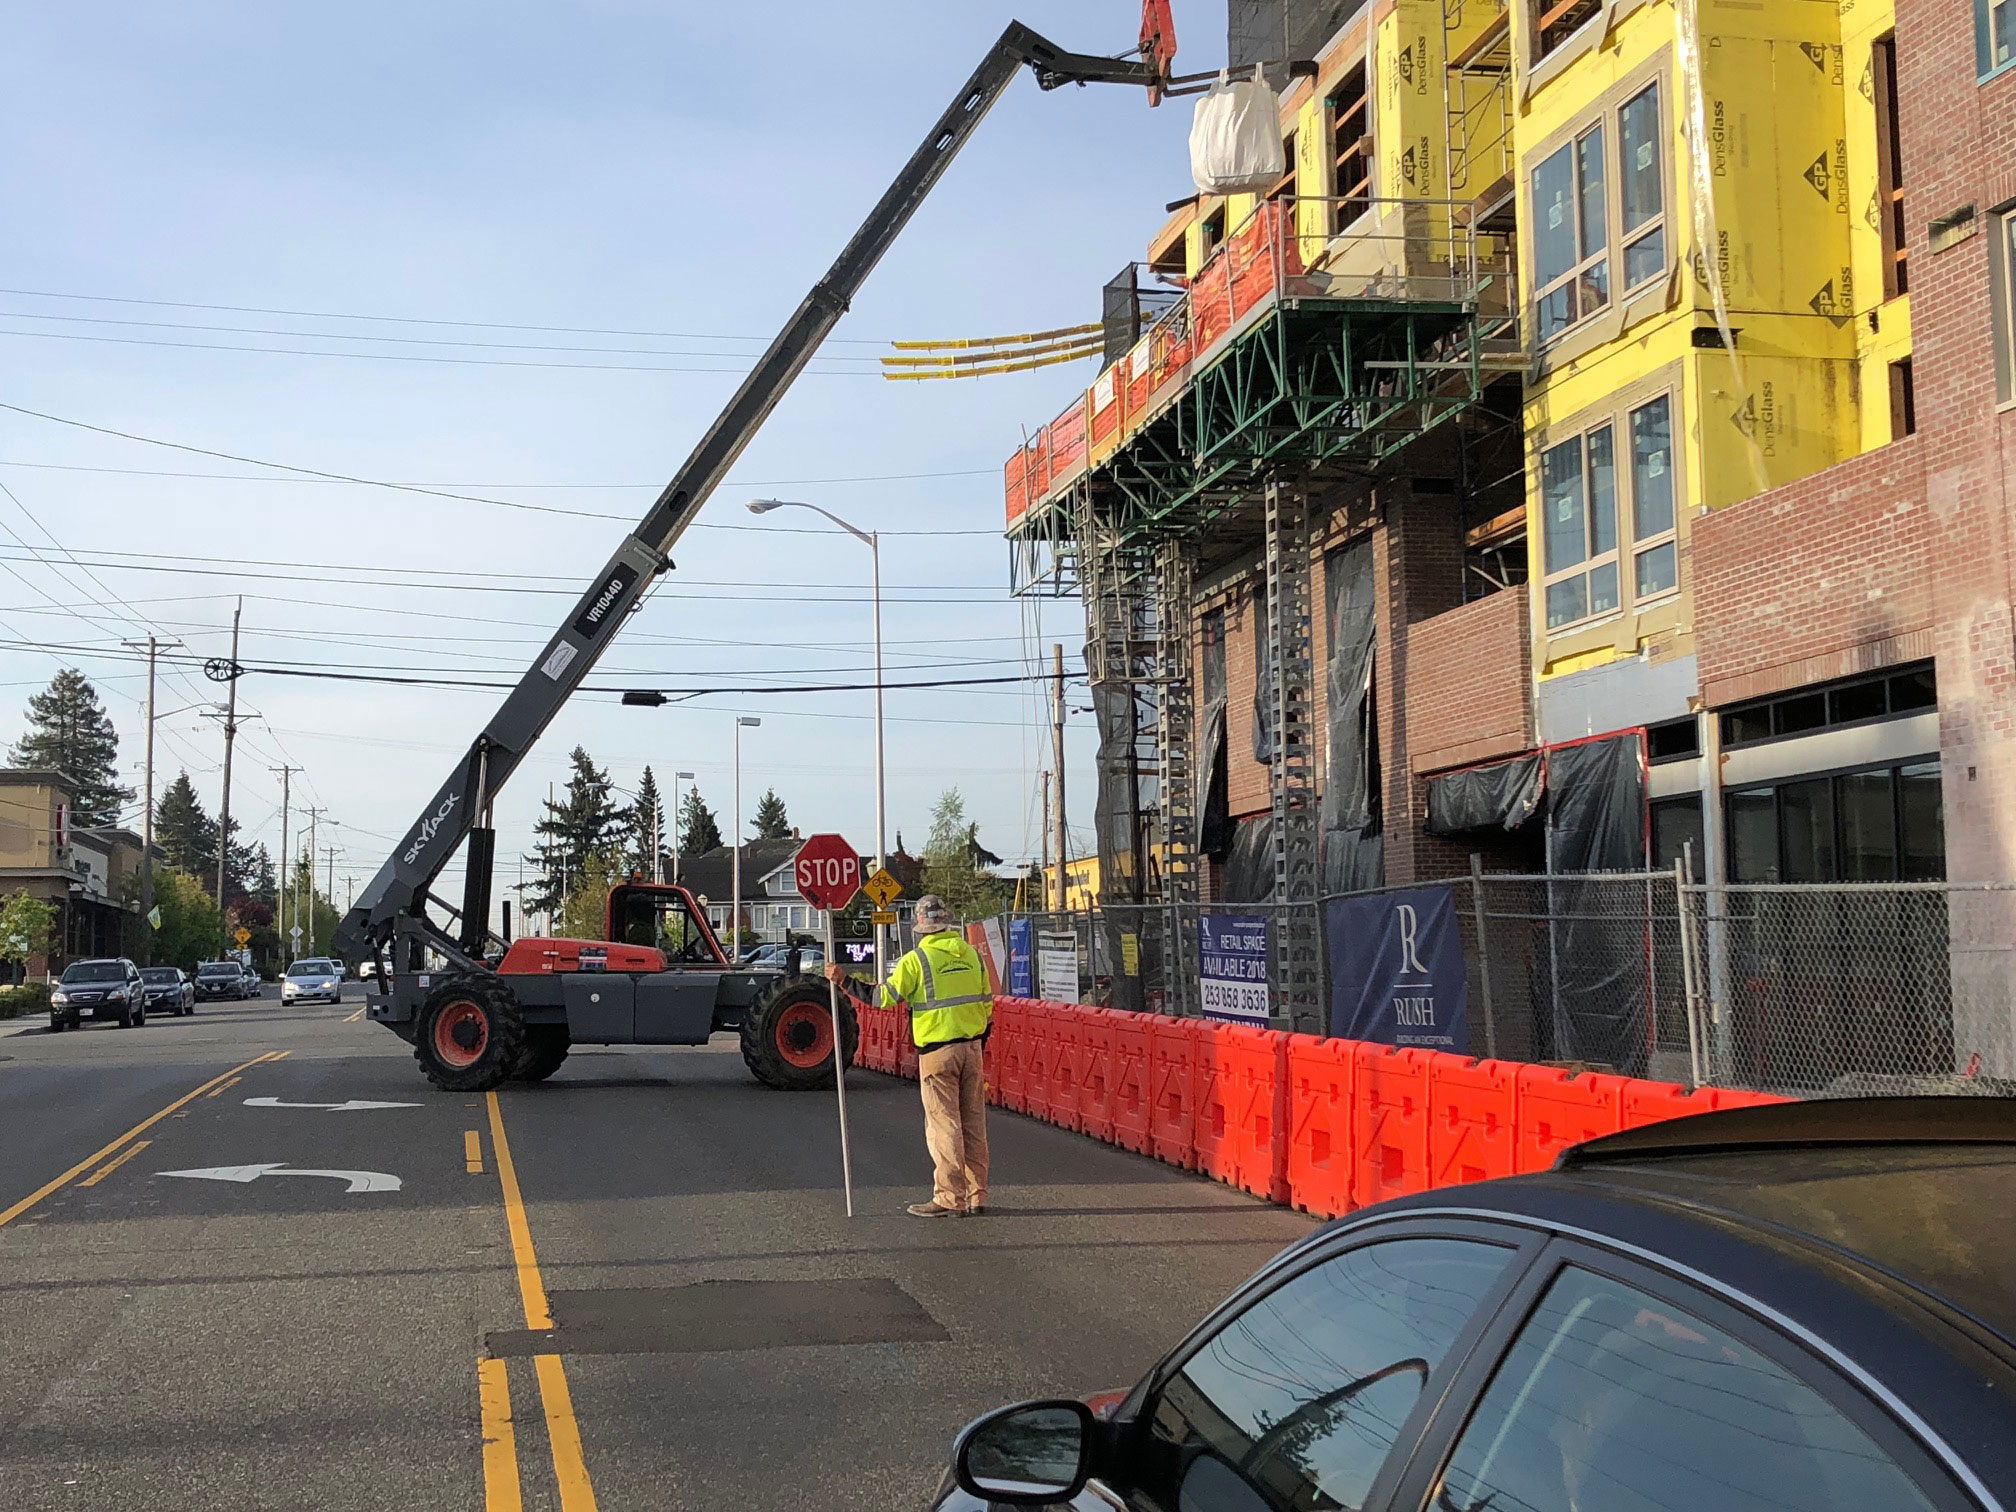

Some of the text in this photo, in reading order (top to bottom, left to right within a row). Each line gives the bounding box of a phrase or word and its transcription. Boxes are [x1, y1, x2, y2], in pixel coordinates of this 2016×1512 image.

[1400, 54, 1411, 77] GP
[1417, 36, 1427, 95] DensGlass
[1863, 69, 1872, 98] GP
[1712, 100, 1727, 177] DensGlass
[1402, 155, 1413, 178] GP
[1419, 136, 1430, 196] DensGlass
[1813, 162, 1827, 191] GP
[1833, 139, 1848, 214] DensGlass
[1869, 199, 1879, 228] GP
[1761, 381, 1776, 457] DensGlass
[586, 579, 623, 622] VR1044D
[403, 792, 460, 865] SKYJACK
[799, 858, 856, 887] STOP
[1202, 917, 1211, 937] R
[1396, 904, 1428, 974] R
[862, 944, 875, 954] AM
[1220, 934, 1242, 950] RETAIL
[1243, 935, 1266, 951] SPACE
[1203, 957, 1266, 979] AVAILABLE 2018
[1205, 984, 1266, 1011] 253 858 3636
[1392, 997, 1435, 1026] RUSH
